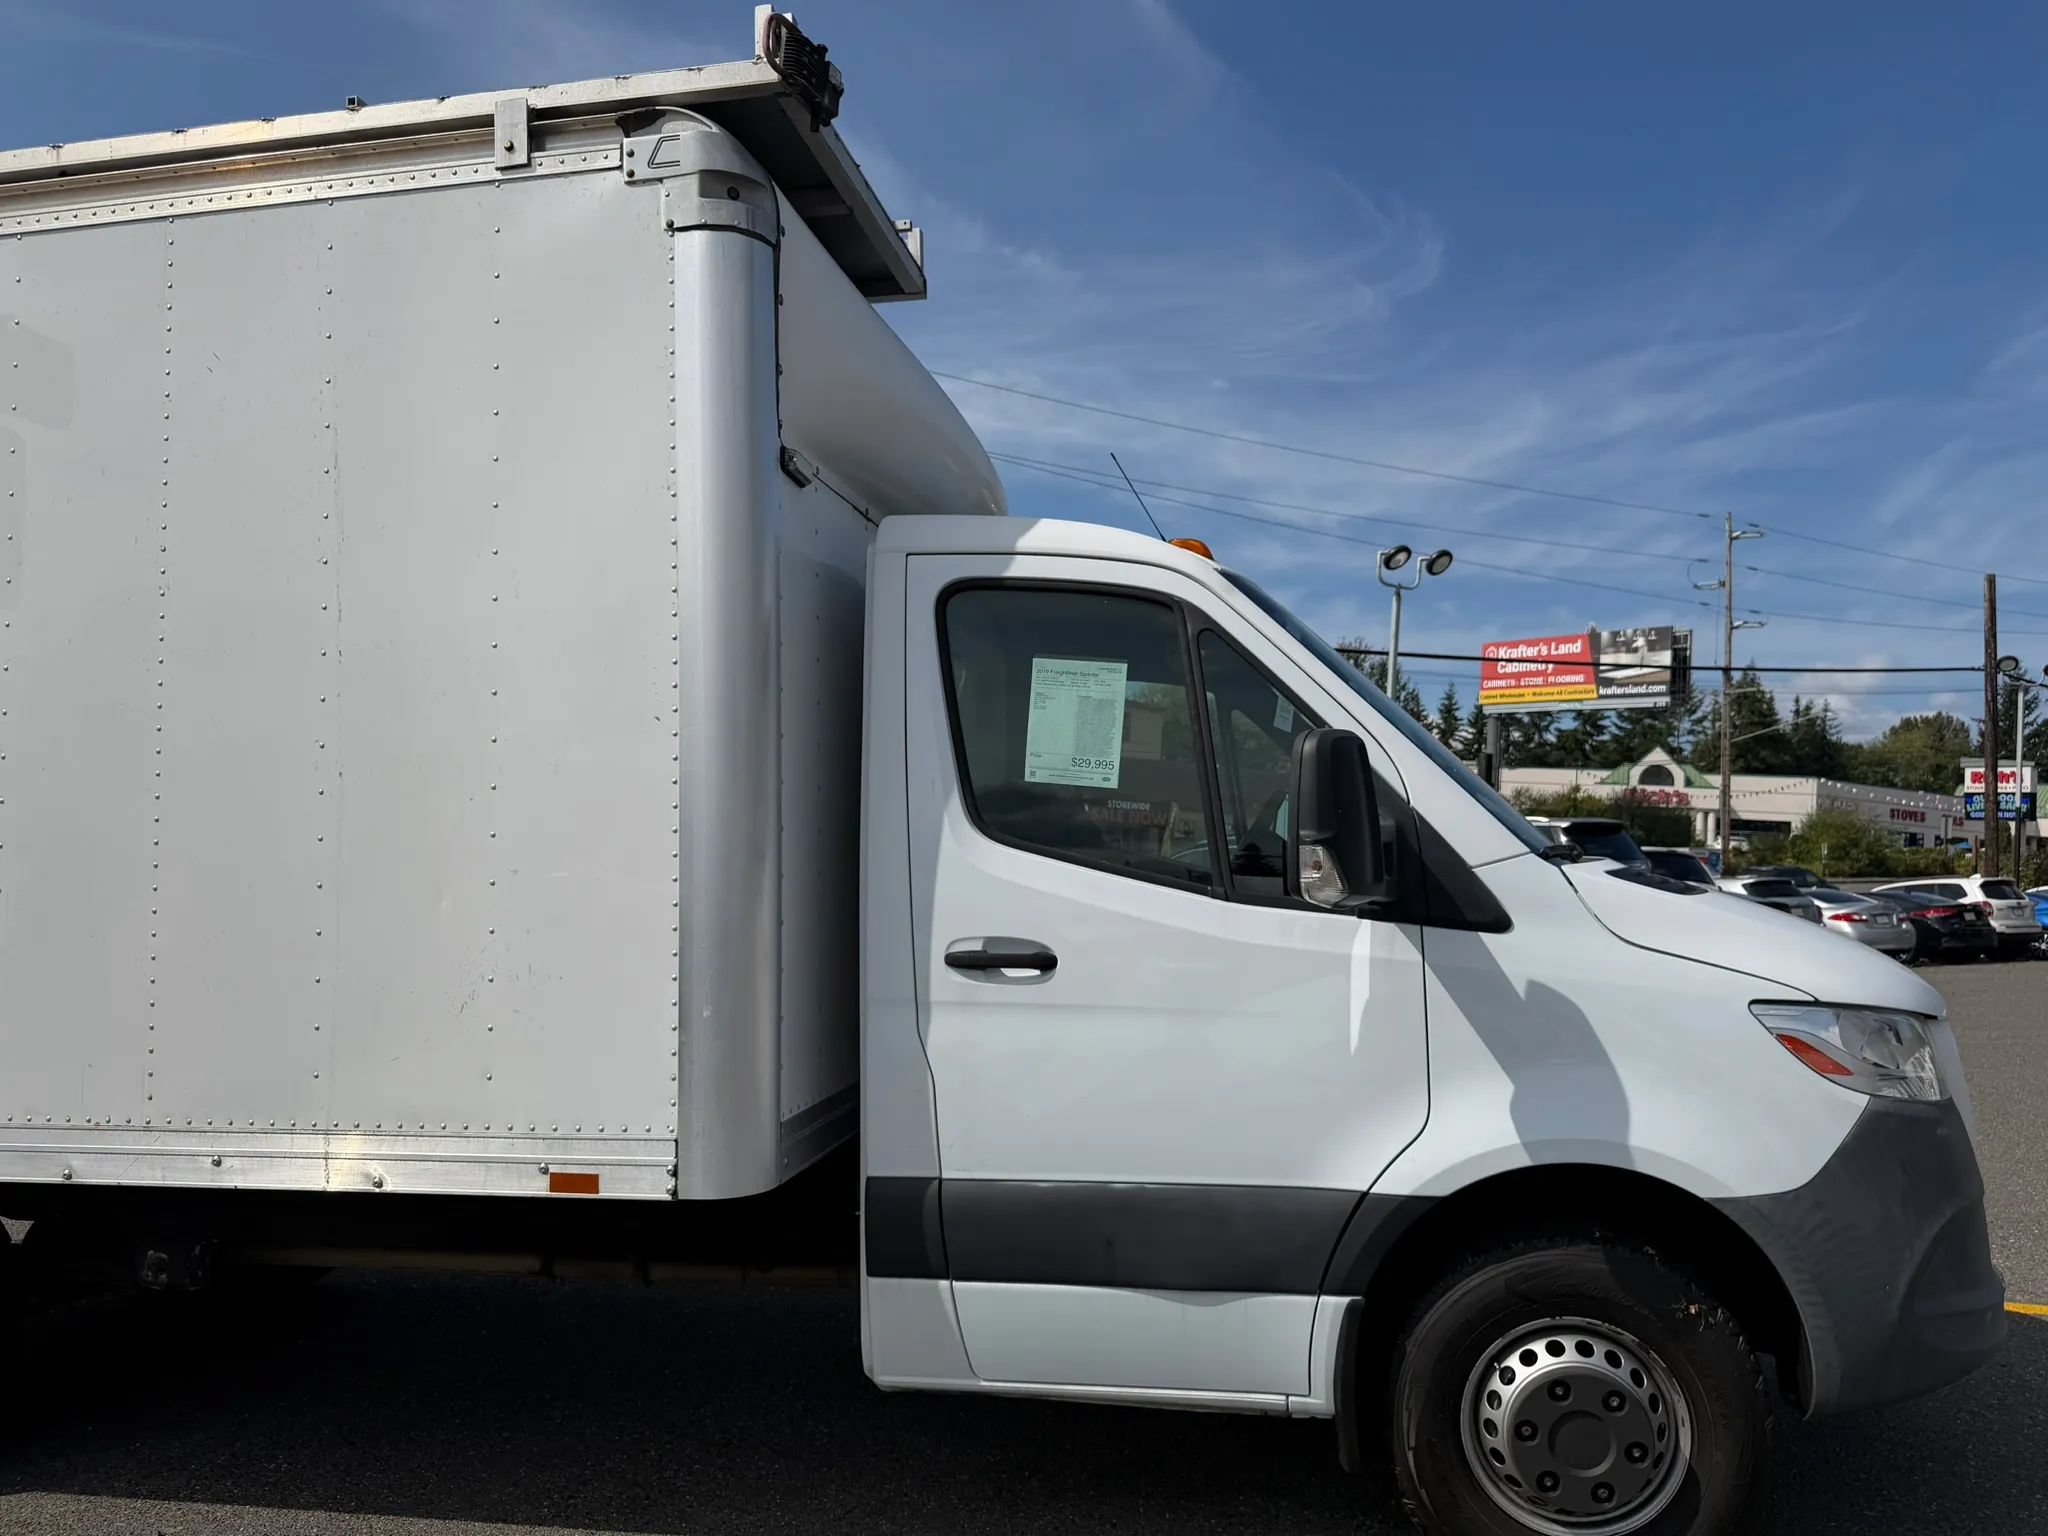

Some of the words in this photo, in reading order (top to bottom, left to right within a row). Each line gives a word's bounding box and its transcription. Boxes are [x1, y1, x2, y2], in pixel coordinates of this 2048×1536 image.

[1498, 642, 1549, 659] Krafter's
[1550, 638, 1582, 655] Land
[1483, 679, 1516, 688] CABINETS
[1548, 674, 1585, 684] FLOORING
[1599, 684, 1667, 696] kraftersland.com
[1071, 757, 1115, 771] $29,995
[1889, 808, 1926, 823] STOVES
